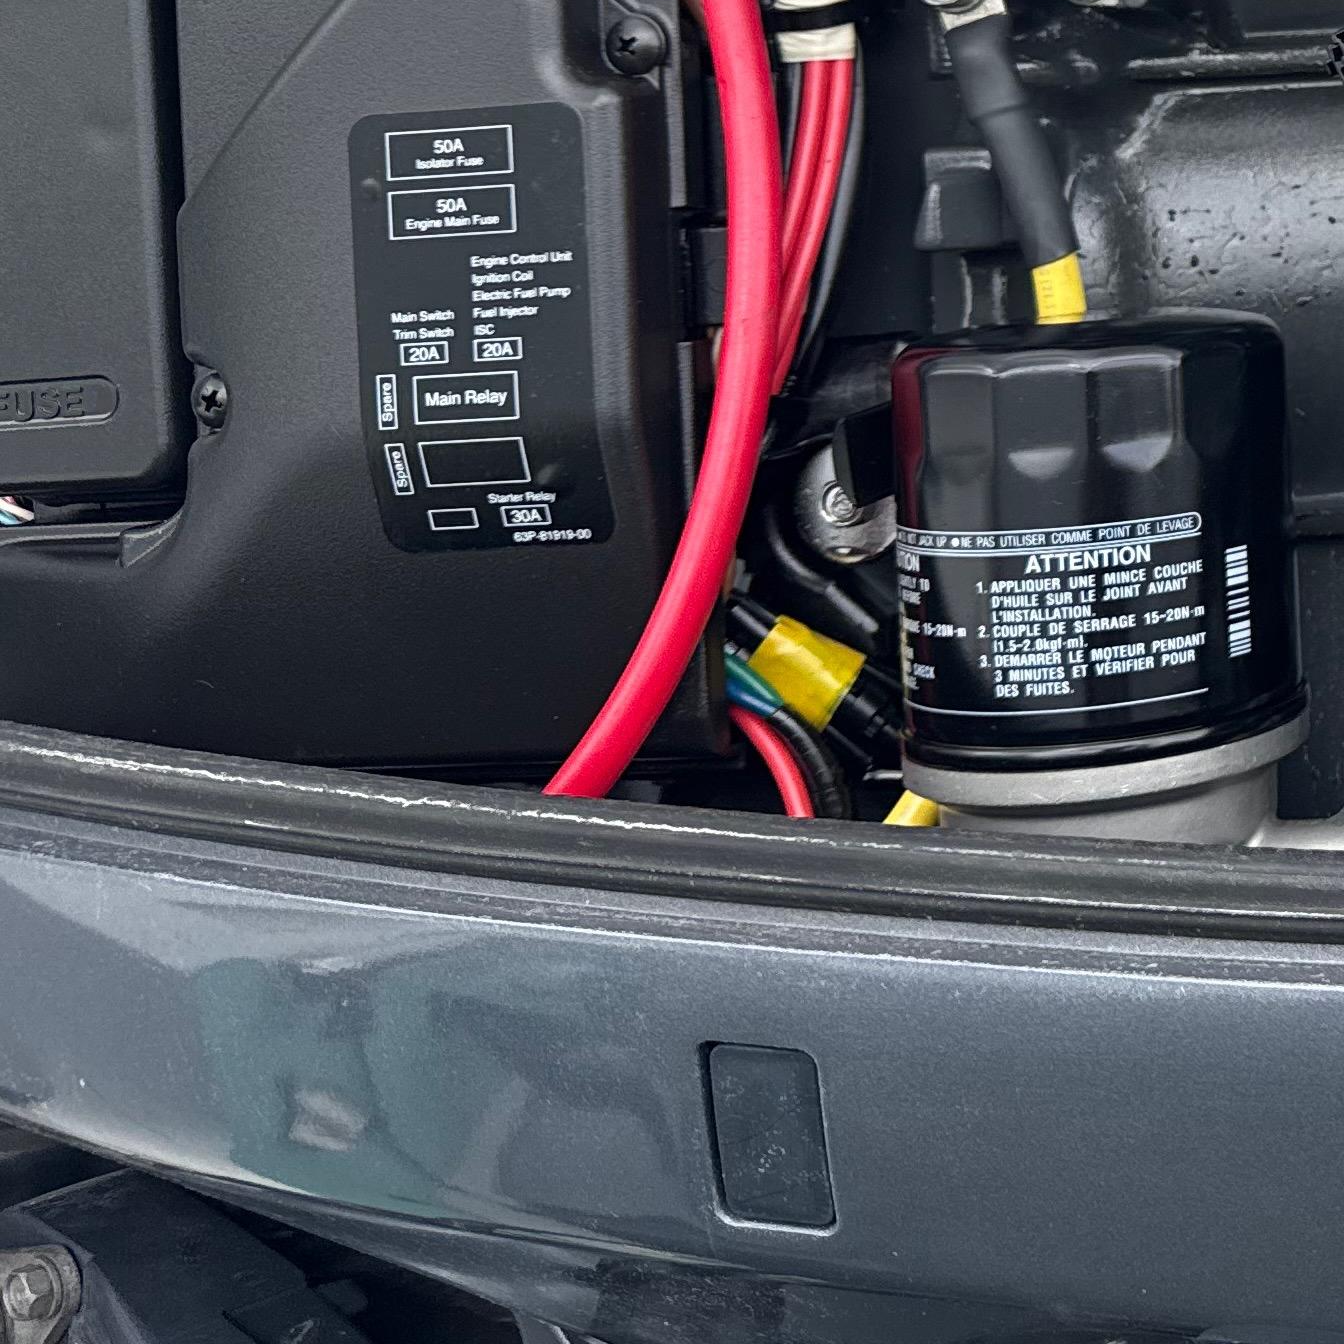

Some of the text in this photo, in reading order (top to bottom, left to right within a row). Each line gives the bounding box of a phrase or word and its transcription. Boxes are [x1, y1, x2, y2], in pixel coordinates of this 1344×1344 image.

[433, 138, 464, 154] 50A
[415, 155, 484, 169] Isolator Fuse
[436, 198, 468, 213] 50A
[405, 214, 500, 231] Engine Main Fuse
[471, 251, 573, 269] Engine Control Unit
[471, 270, 534, 286] Ignition Coil
[472, 287, 571, 302] Electric Fuel Pump
[391, 310, 455, 323] Main Switch
[473, 305, 539, 319] Fuel Injector
[393, 327, 454, 340] Trim Switch
[474, 324, 496, 336] ISC
[408, 347, 440, 362] 20A
[482, 341, 514, 357] 20A
[382, 382, 397, 422] Spare
[424, 388, 508, 407] Main Relay
[392, 451, 408, 488] Spare
[487, 491, 556, 505] Starter Relay
[511, 509, 543, 523] 30A
[936, 535, 947, 547] UP
[976, 536, 995, 548] PAS
[1000, 533, 1046, 547] UTILISER
[1051, 529, 1092, 545] COMME
[1099, 525, 1131, 539] POINT
[1137, 523, 1151, 536] DE
[1157, 517, 1195, 533] LEVAGE
[1024, 544, 1151, 574] ATTENTION
[976, 559, 1203, 594] 1. APPLIQUER UNE MINCE COUCHE
[991, 577, 1188, 609] D'HUILE SUR LE JOINT AVANT
[992, 605, 1096, 623] L'INSTALLATION.
[992, 623, 1041, 637] COUPLE
[1049, 622, 1066, 635] DE
[1073, 613, 1136, 634] SERRAGE
[994, 652, 1061, 668] DEMARRER
[1068, 650, 1084, 664] LE
[1091, 643, 1145, 662] MOTEUR
[1152, 632, 1206, 653] PENDANT
[993, 669, 1003, 683] 3
[1009, 666, 1065, 682] MINUTES
[1072, 664, 1088, 678] ET
[1162, 649, 1195, 667] POUR
[996, 680, 1075, 697] DES FUITES.
